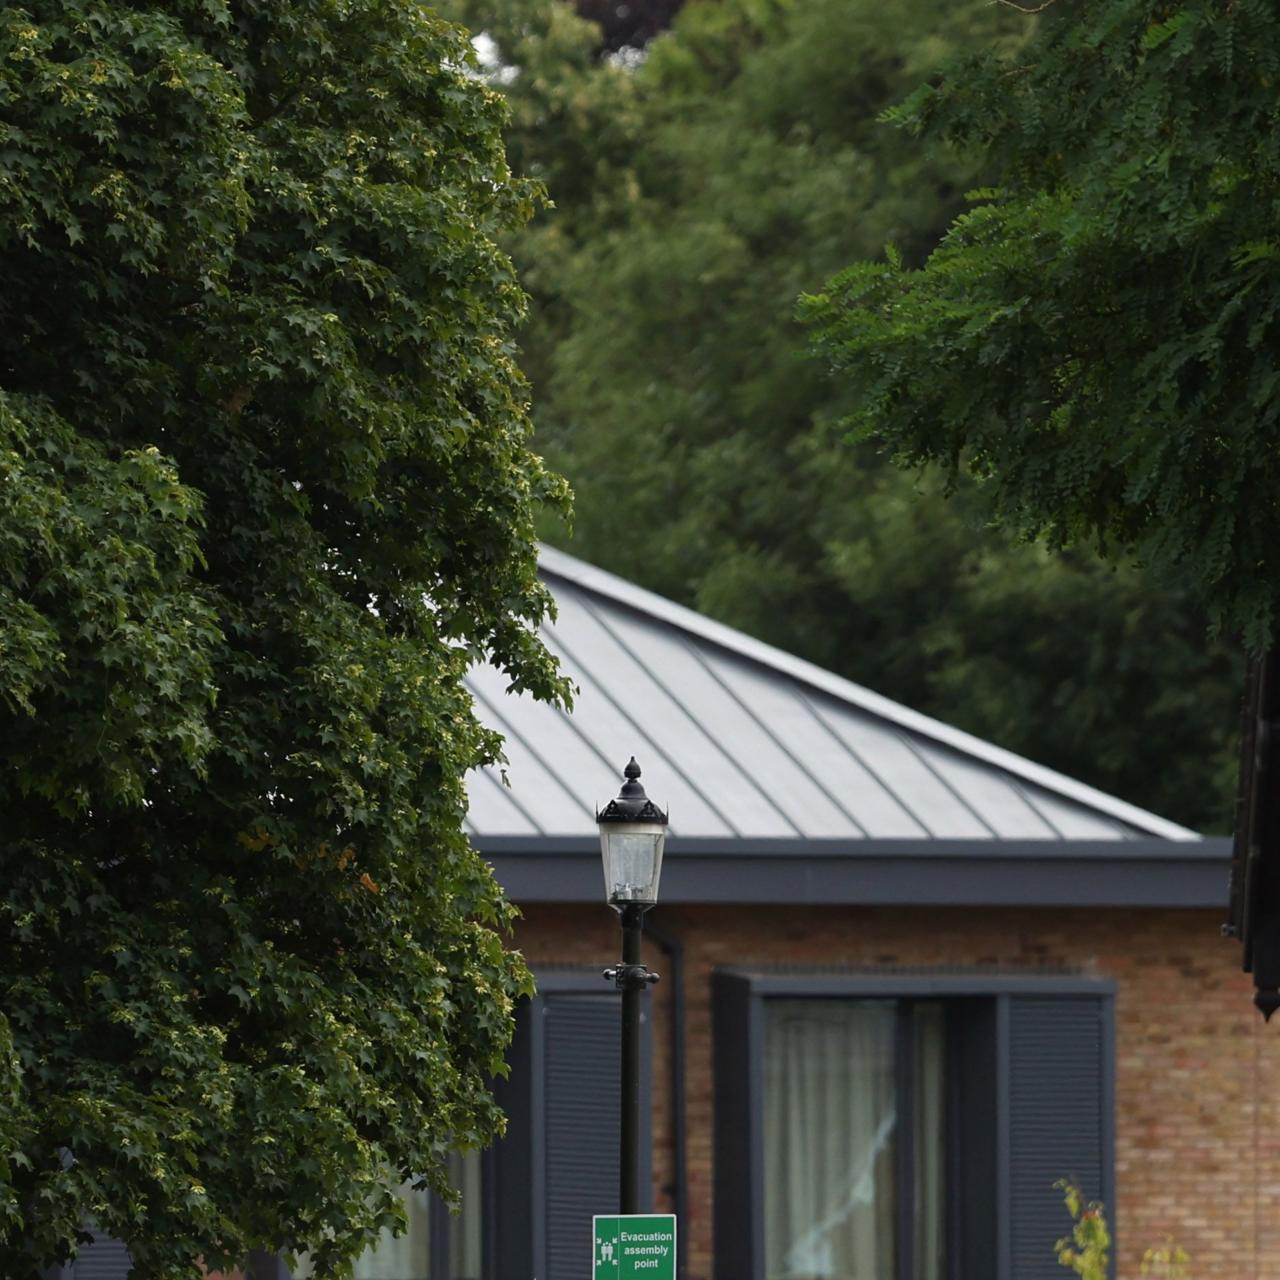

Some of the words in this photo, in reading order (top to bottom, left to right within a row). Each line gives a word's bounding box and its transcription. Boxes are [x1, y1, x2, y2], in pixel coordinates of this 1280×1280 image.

[620, 1232, 672, 1242] Evacuation
[624, 1245, 668, 1257] assembly
[634, 1259, 659, 1271] point
